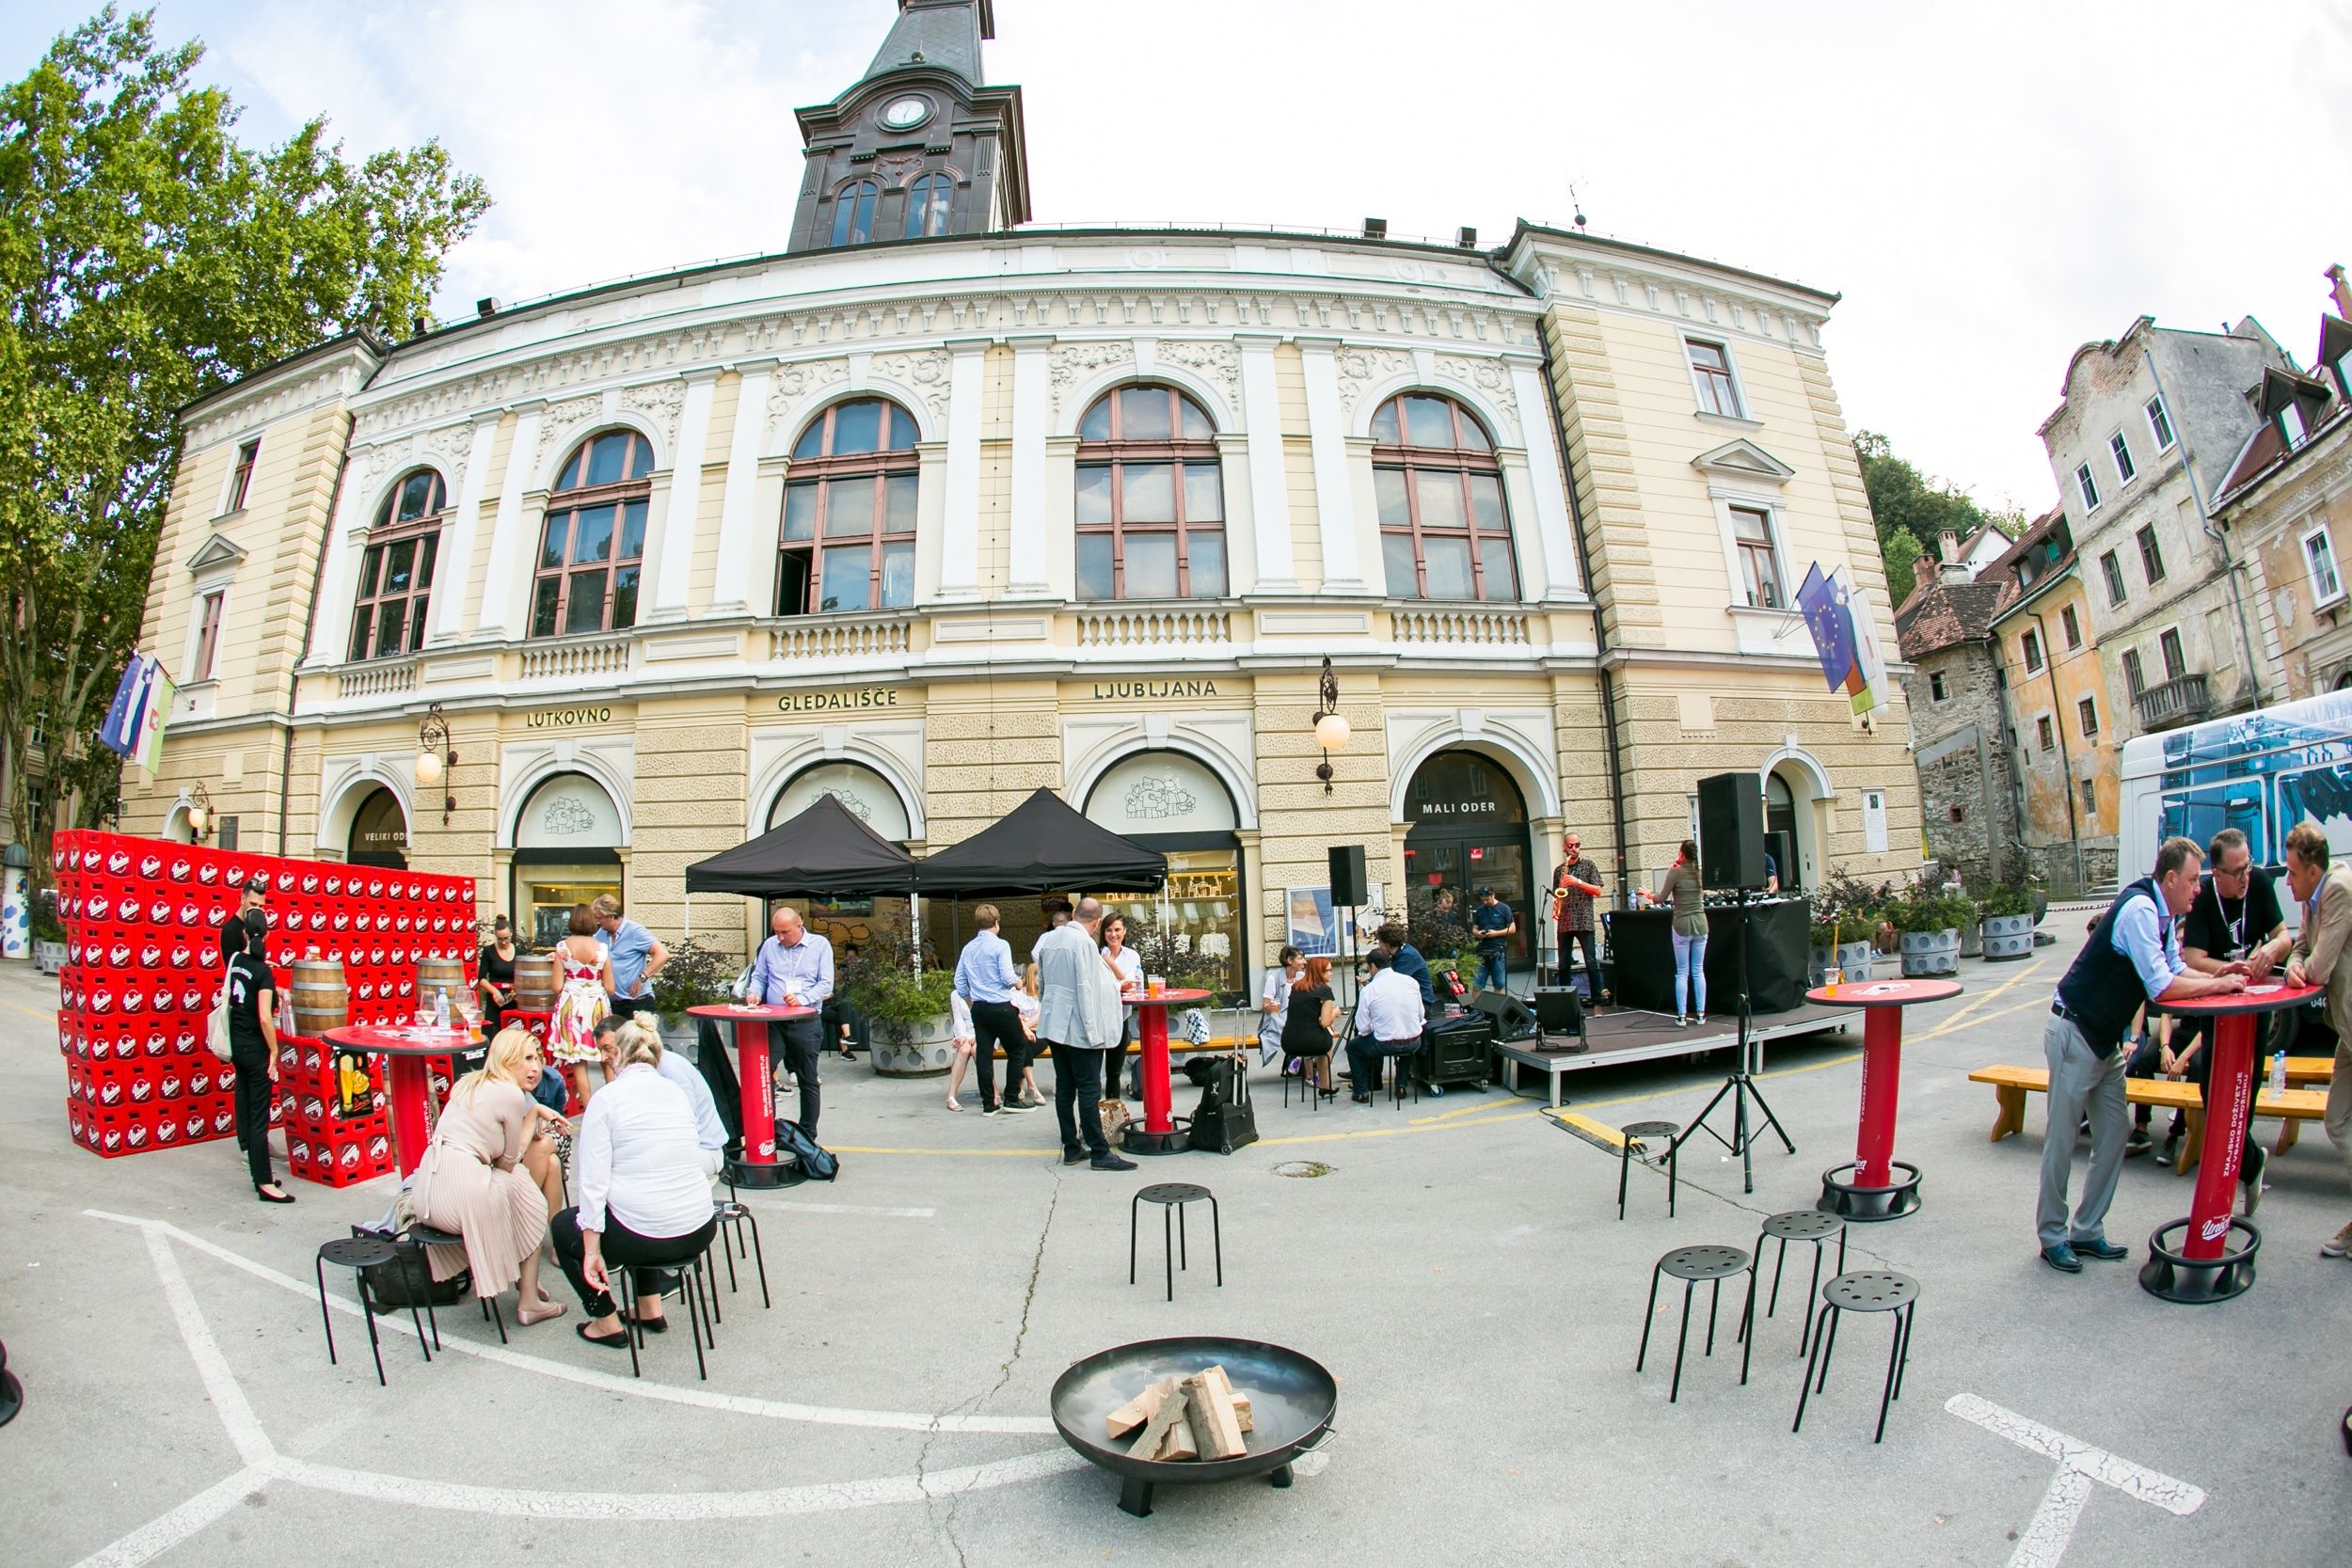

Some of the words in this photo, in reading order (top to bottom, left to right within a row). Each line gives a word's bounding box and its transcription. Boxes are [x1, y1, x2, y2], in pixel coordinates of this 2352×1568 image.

[527, 707, 612, 727] LUTKOVNO
[778, 687, 897, 711] GLEDALIŠČE
[1094, 680, 1217, 700] LJUBLJANA
[1422, 803, 1455, 814] MALI
[1460, 801, 1496, 813] ODER
[364, 832, 390, 841] VELIKI
[2223, 1130, 2236, 1177] ZMAJSKO
[2231, 1071, 2243, 1128] DOŽIVETJE
